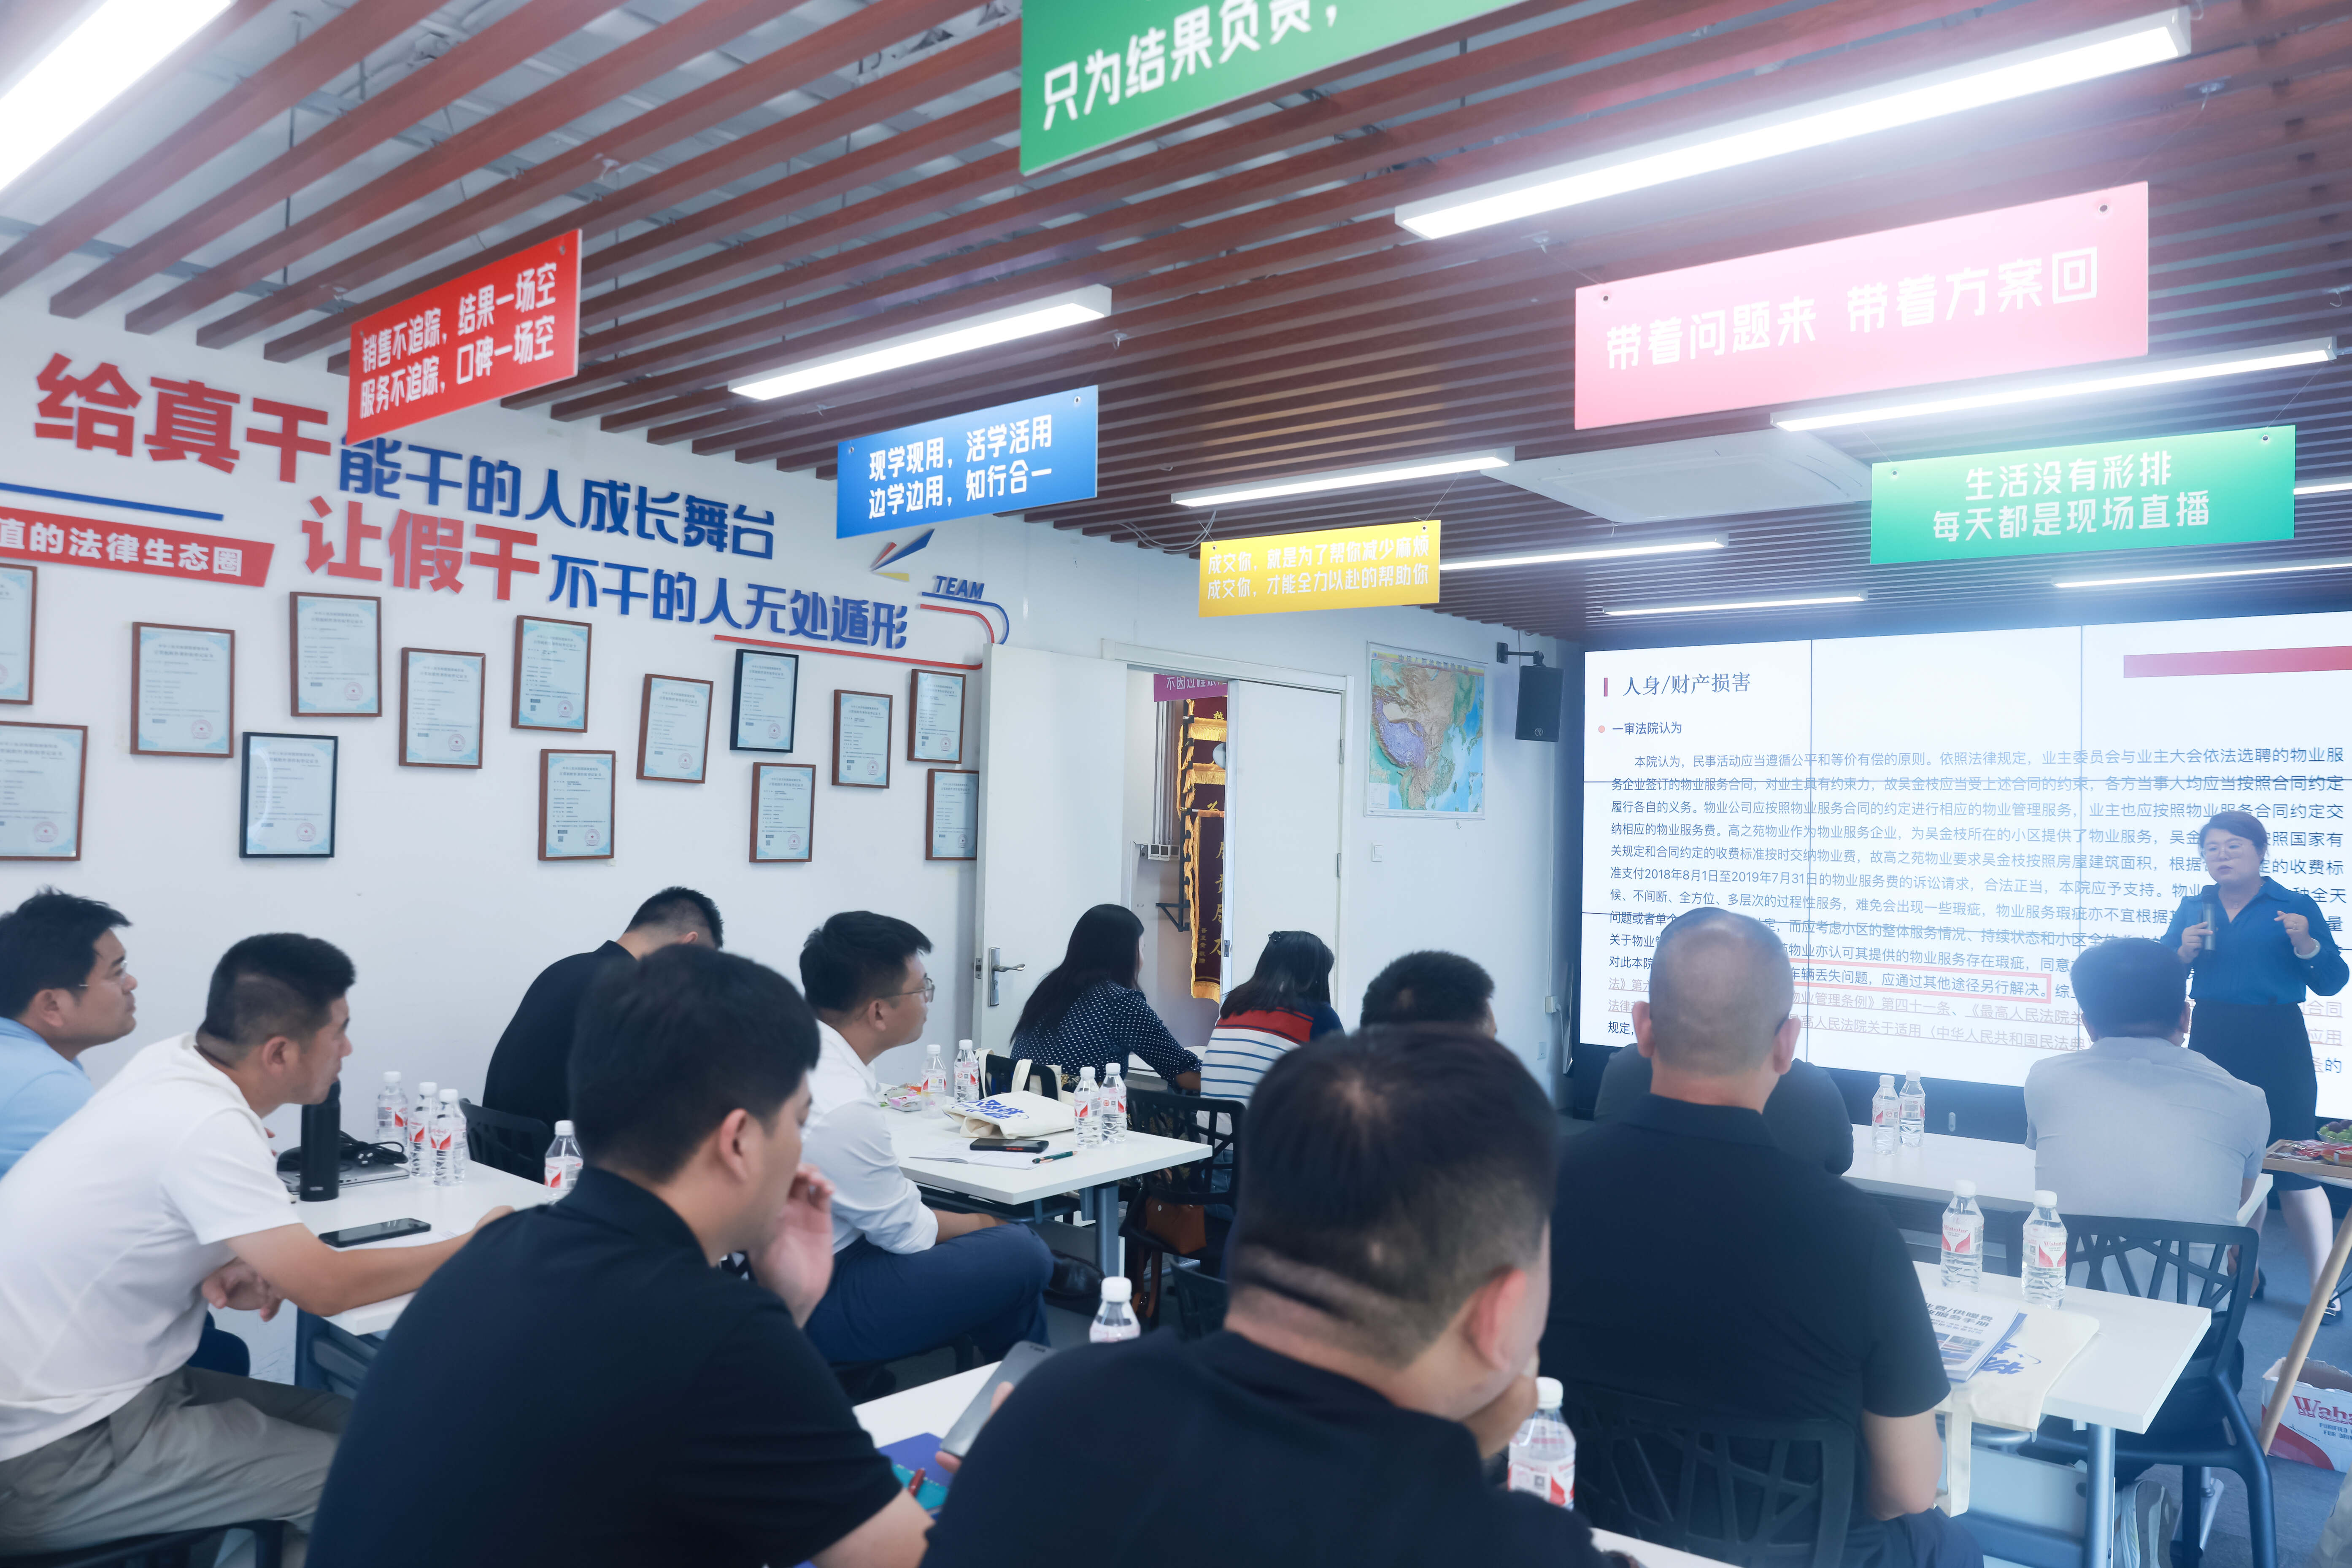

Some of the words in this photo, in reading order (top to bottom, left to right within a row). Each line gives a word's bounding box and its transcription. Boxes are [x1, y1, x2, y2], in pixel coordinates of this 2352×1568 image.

[1607, 295, 1817, 370] 带着问题来
[1847, 246, 2099, 332] 带着方案回
[35, 353, 331, 483] 给真干
[340, 436, 775, 560] 能干的人成长舞台
[869, 414, 1052, 482] 现学现用，活学活用
[869, 459, 1052, 519] 边学边用，知行合一
[1965, 450, 2173, 501] 生活没有彩排
[1932, 490, 2210, 542] 每天都是现场直播
[302, 495, 540, 601] 让假干
[548, 553, 908, 650] 不干的人无处遁形
[936, 575, 985, 600] TEAM
[1623, 671, 1750, 696] 人身/财产损害
[1612, 721, 1682, 735] 一审法院认为
[2292, 1395, 2352, 1425] Wah
